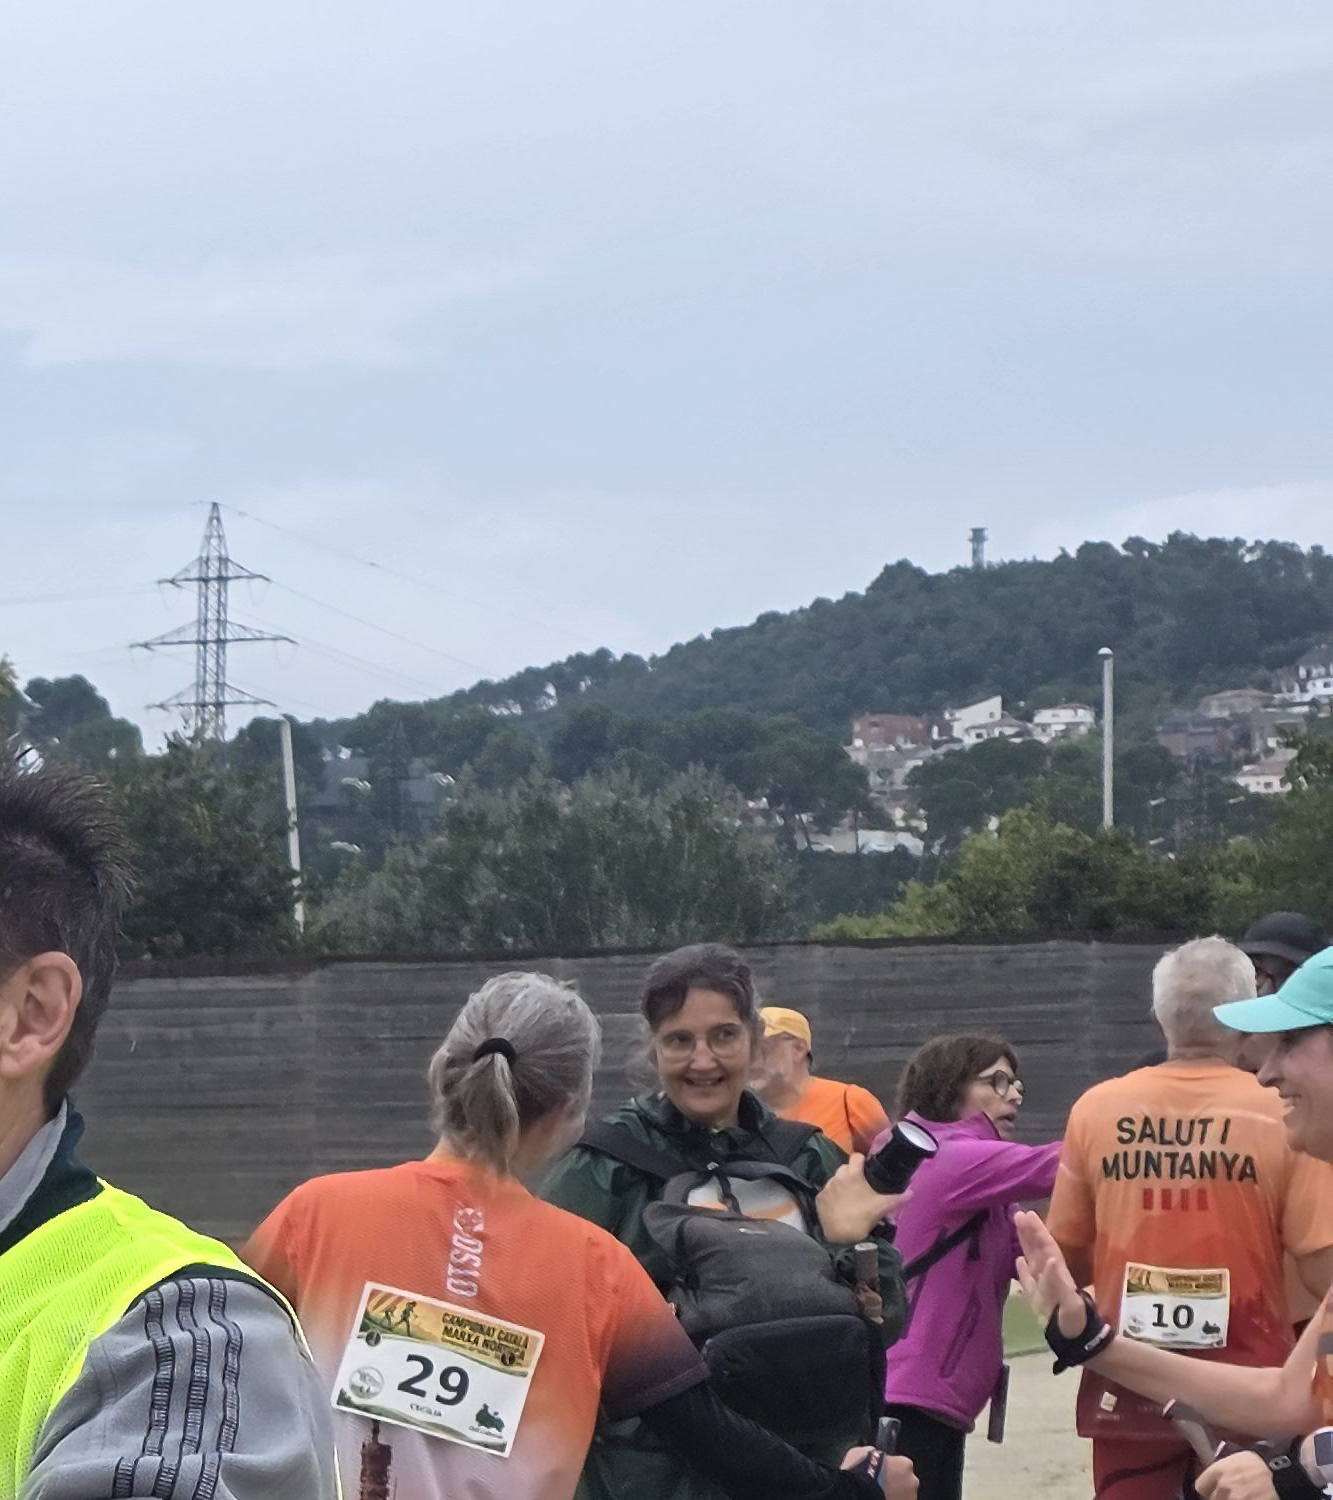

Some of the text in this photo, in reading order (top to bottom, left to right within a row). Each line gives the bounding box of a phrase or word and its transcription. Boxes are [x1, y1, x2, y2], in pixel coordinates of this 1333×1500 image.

[1116, 1114, 1231, 1146] SALUT I
[1101, 1150, 1258, 1184] MUNTANYA
[446, 1233, 484, 1297] OTSO
[1151, 1303, 1195, 1329] 10
[396, 1354, 470, 1406] 29
